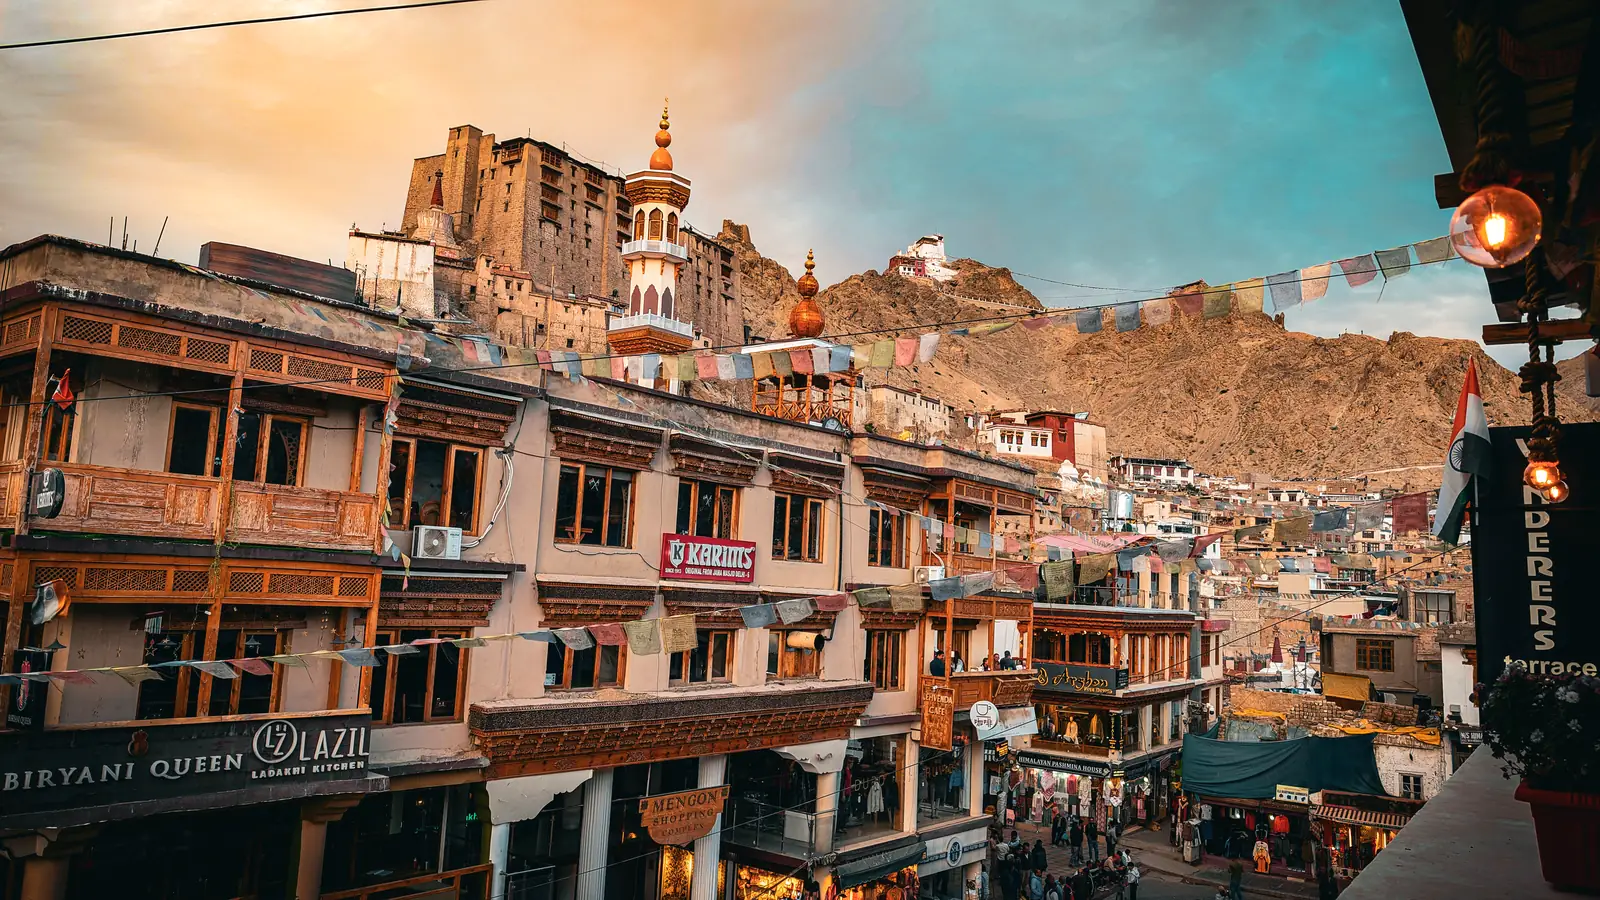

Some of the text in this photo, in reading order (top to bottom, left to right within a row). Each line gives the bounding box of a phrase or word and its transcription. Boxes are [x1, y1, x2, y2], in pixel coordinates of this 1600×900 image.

[1515, 438, 1557, 651] NDERERS
[299, 727, 370, 761] LAZIL
[3, 753, 244, 791] BIRYANI QUEEN
[252, 761, 365, 779] LADAKHI KITCHEN
[1018, 756, 1051, 767] HIMALAYAN
[1051, 761, 1081, 771] PASHMINA
[1082, 765, 1102, 774] HOUSE
[652, 790, 718, 813] MENGON
[652, 808, 714, 826] SHOPPING
